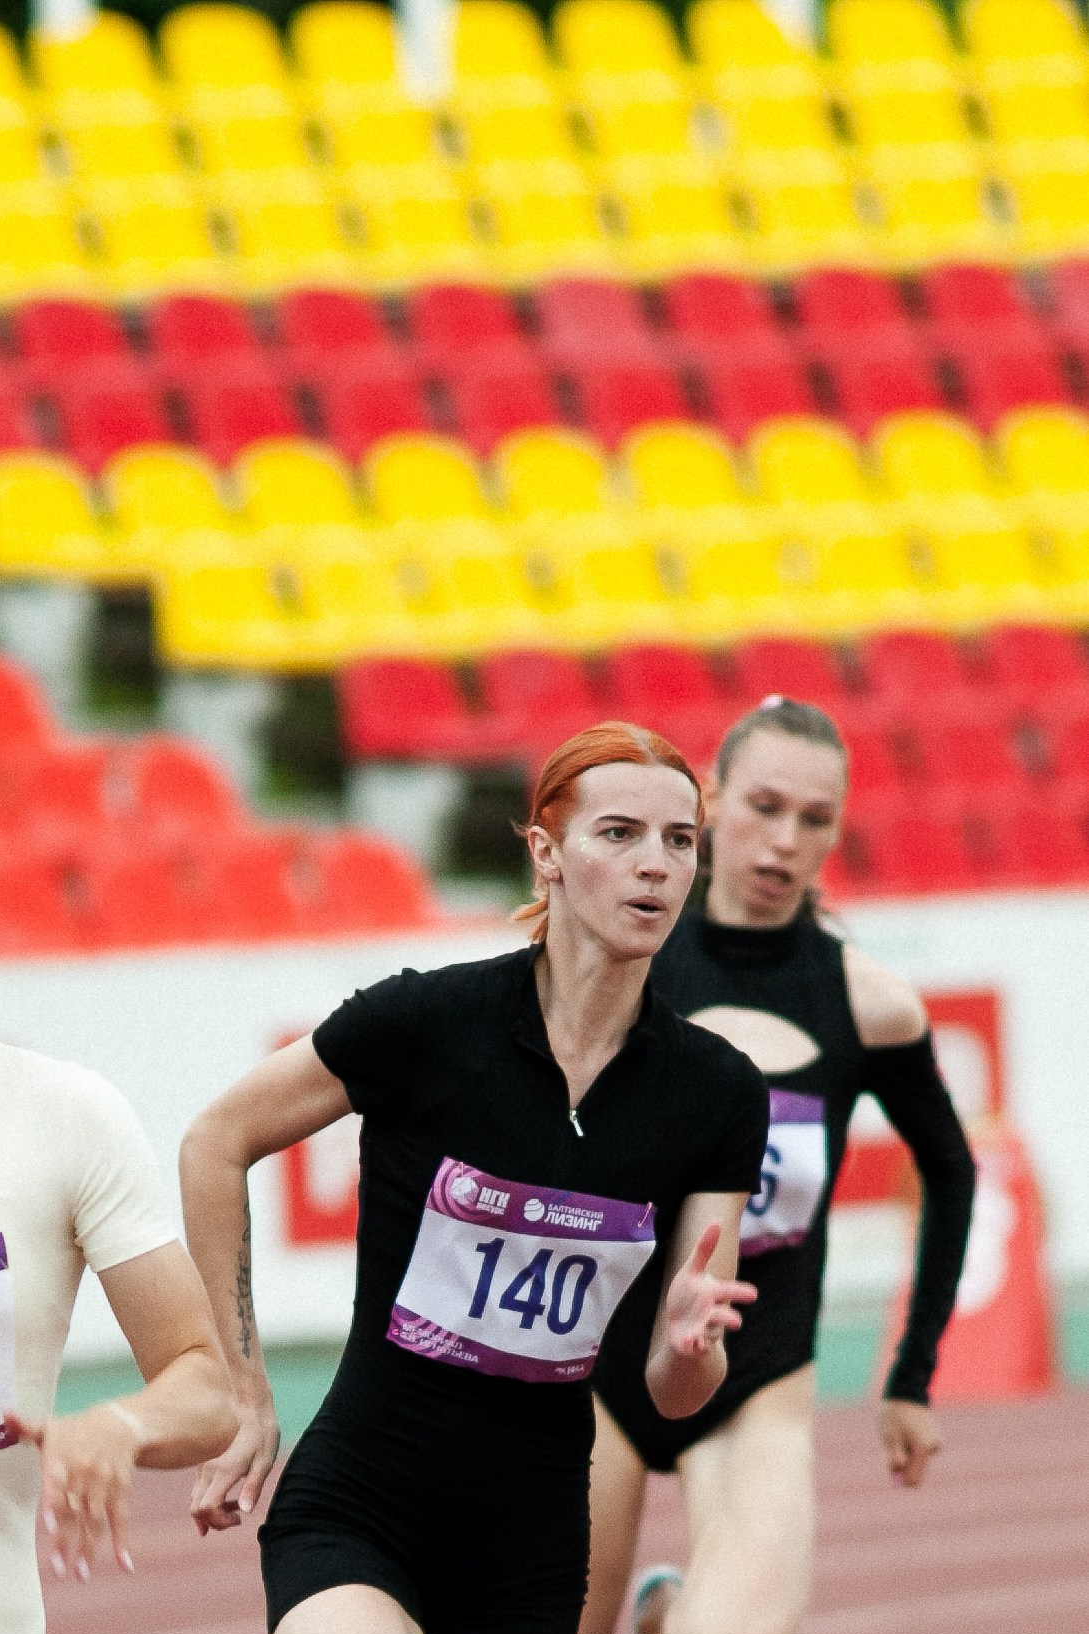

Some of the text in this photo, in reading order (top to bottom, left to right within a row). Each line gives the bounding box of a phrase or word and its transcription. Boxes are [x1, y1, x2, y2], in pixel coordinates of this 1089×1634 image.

[544, 1211, 603, 1232] ЛИЗИНГ
[547, 1203, 604, 1220] БАЛТИЙСКИЙ
[468, 1237, 598, 1335] 140
